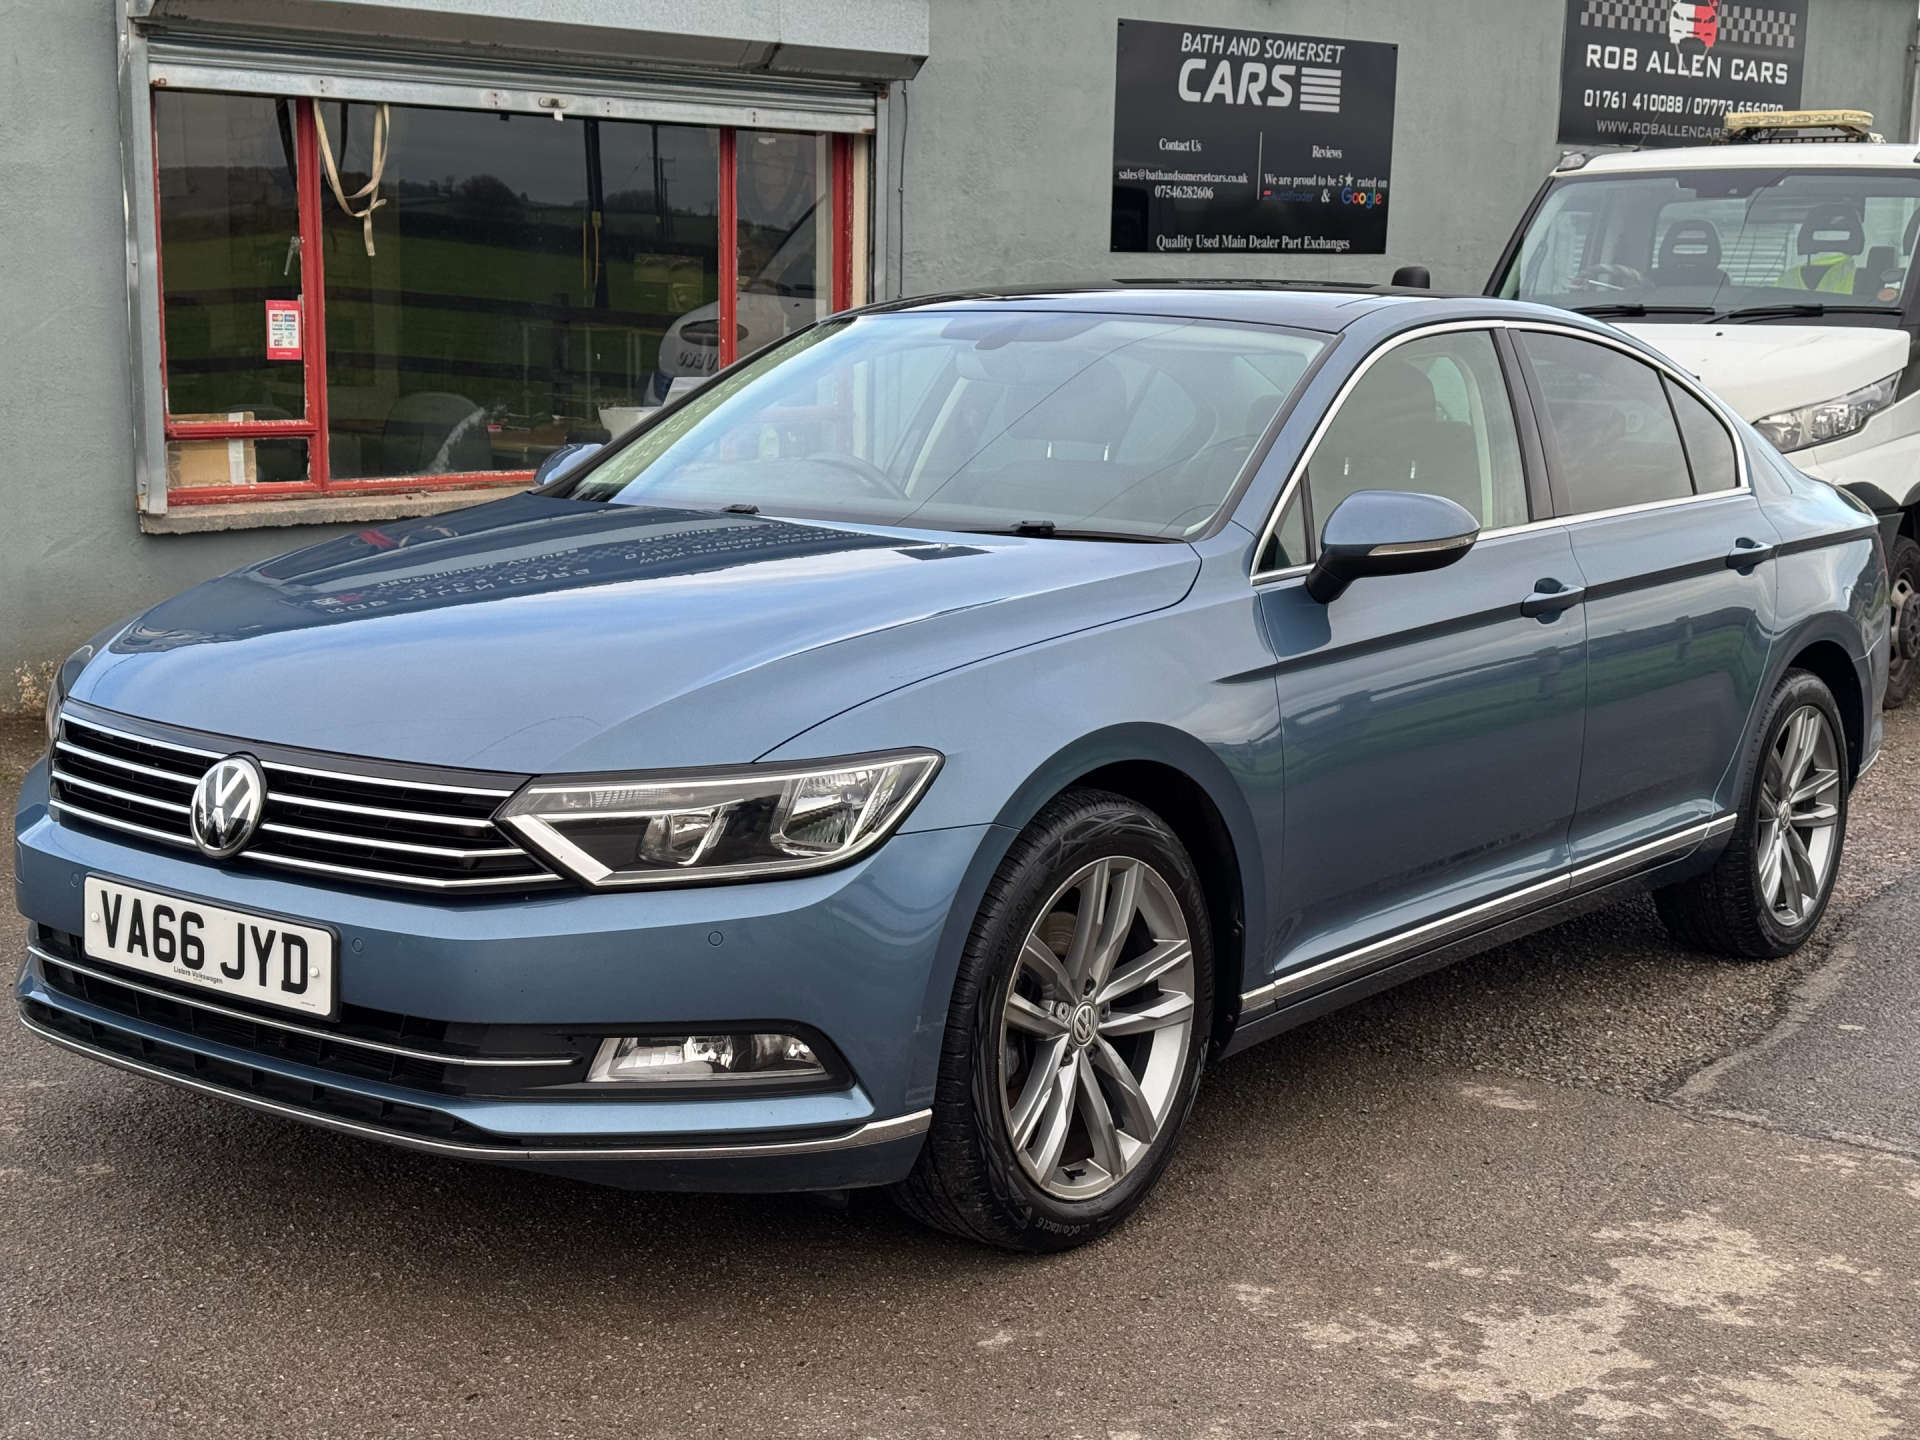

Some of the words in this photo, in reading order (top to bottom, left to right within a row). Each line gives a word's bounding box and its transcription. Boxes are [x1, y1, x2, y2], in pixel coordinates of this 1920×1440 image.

[1181, 32, 1225, 55] BATH
[1226, 36, 1260, 57] AND
[1264, 39, 1345, 64] SOMERSET
[1586, 44, 1637, 71] ROB
[1646, 50, 1722, 79] ALLEN
[1730, 59, 1788, 85] CARS
[1178, 58, 1296, 107] CARS
[1584, 89, 1627, 109] 01761
[1632, 93, 1683, 113] 410088
[1694, 97, 1733, 117] 07773
[1159, 137, 1190, 152] Contact
[1191, 140, 1202, 152] Us
[1312, 144, 1343, 159] Reviews
[1119, 168, 1248, 184] sales@bathandsomersetcars.co.uk
[1264, 173, 1277, 185] We
[1278, 177, 1291, 185] are
[1293, 174, 1316, 188] proud
[1318, 175, 1326, 186] to
[1327, 175, 1337, 186] be
[1338, 175, 1343, 187] 5
[1357, 177, 1377, 188] rated
[1378, 179, 1388, 188] on
[1154, 185, 1214, 200] 07546282606
[1320, 188, 1331, 203] &
[1341, 187, 1382, 208] Google
[1156, 234, 1193, 251] Quality
[1195, 234, 1219, 249] Used
[1222, 234, 1247, 249] Main
[1249, 235, 1280, 249] Dealer
[1282, 235, 1301, 249] Part
[1303, 235, 1350, 252] Exchanges
[101, 890, 205, 970] VA66
[220, 922, 308, 995] JYD
